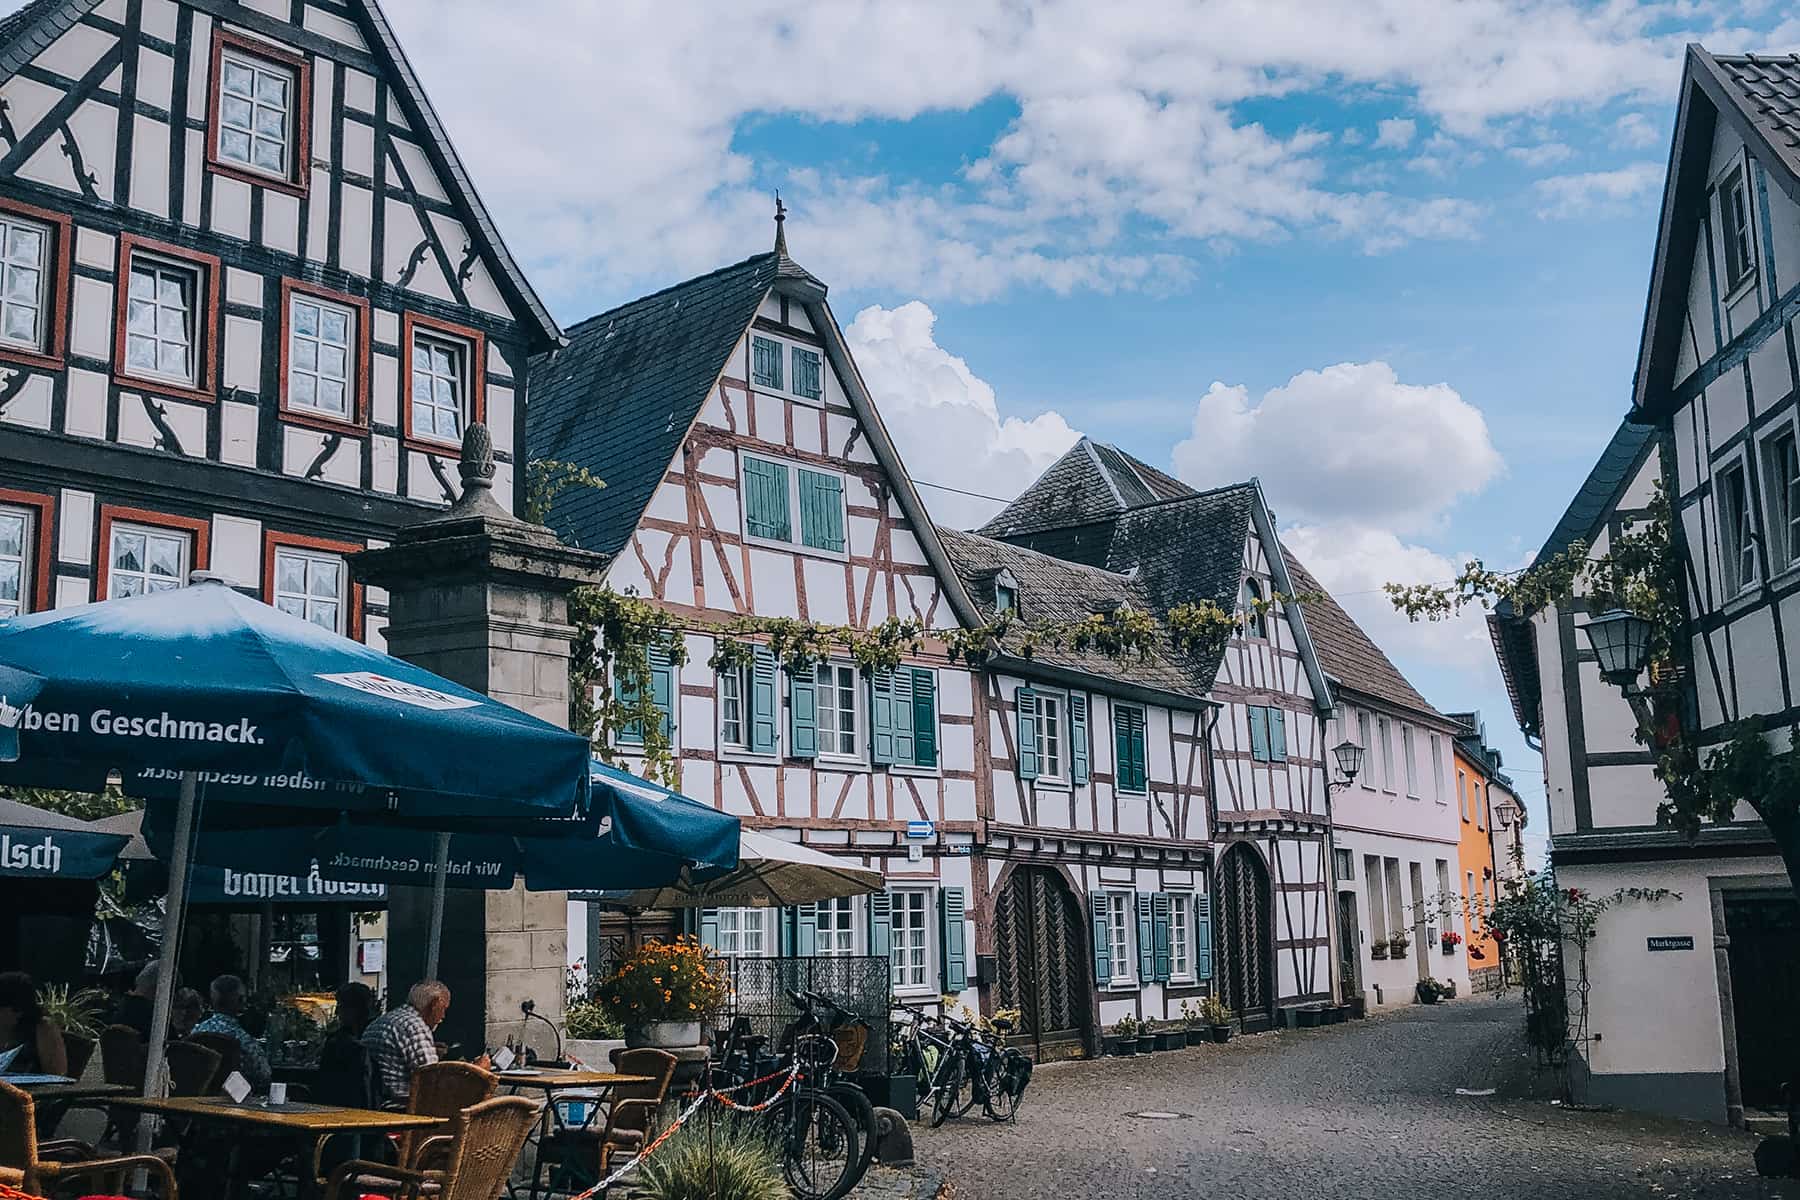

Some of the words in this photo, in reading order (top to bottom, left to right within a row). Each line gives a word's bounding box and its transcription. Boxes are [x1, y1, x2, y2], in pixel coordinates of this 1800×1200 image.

[19, 703, 80, 732] ben
[90, 708, 264, 745] Geschmack.
[1, 834, 61, 873] lsch
[1650, 938, 1692, 949] Marktgasse
